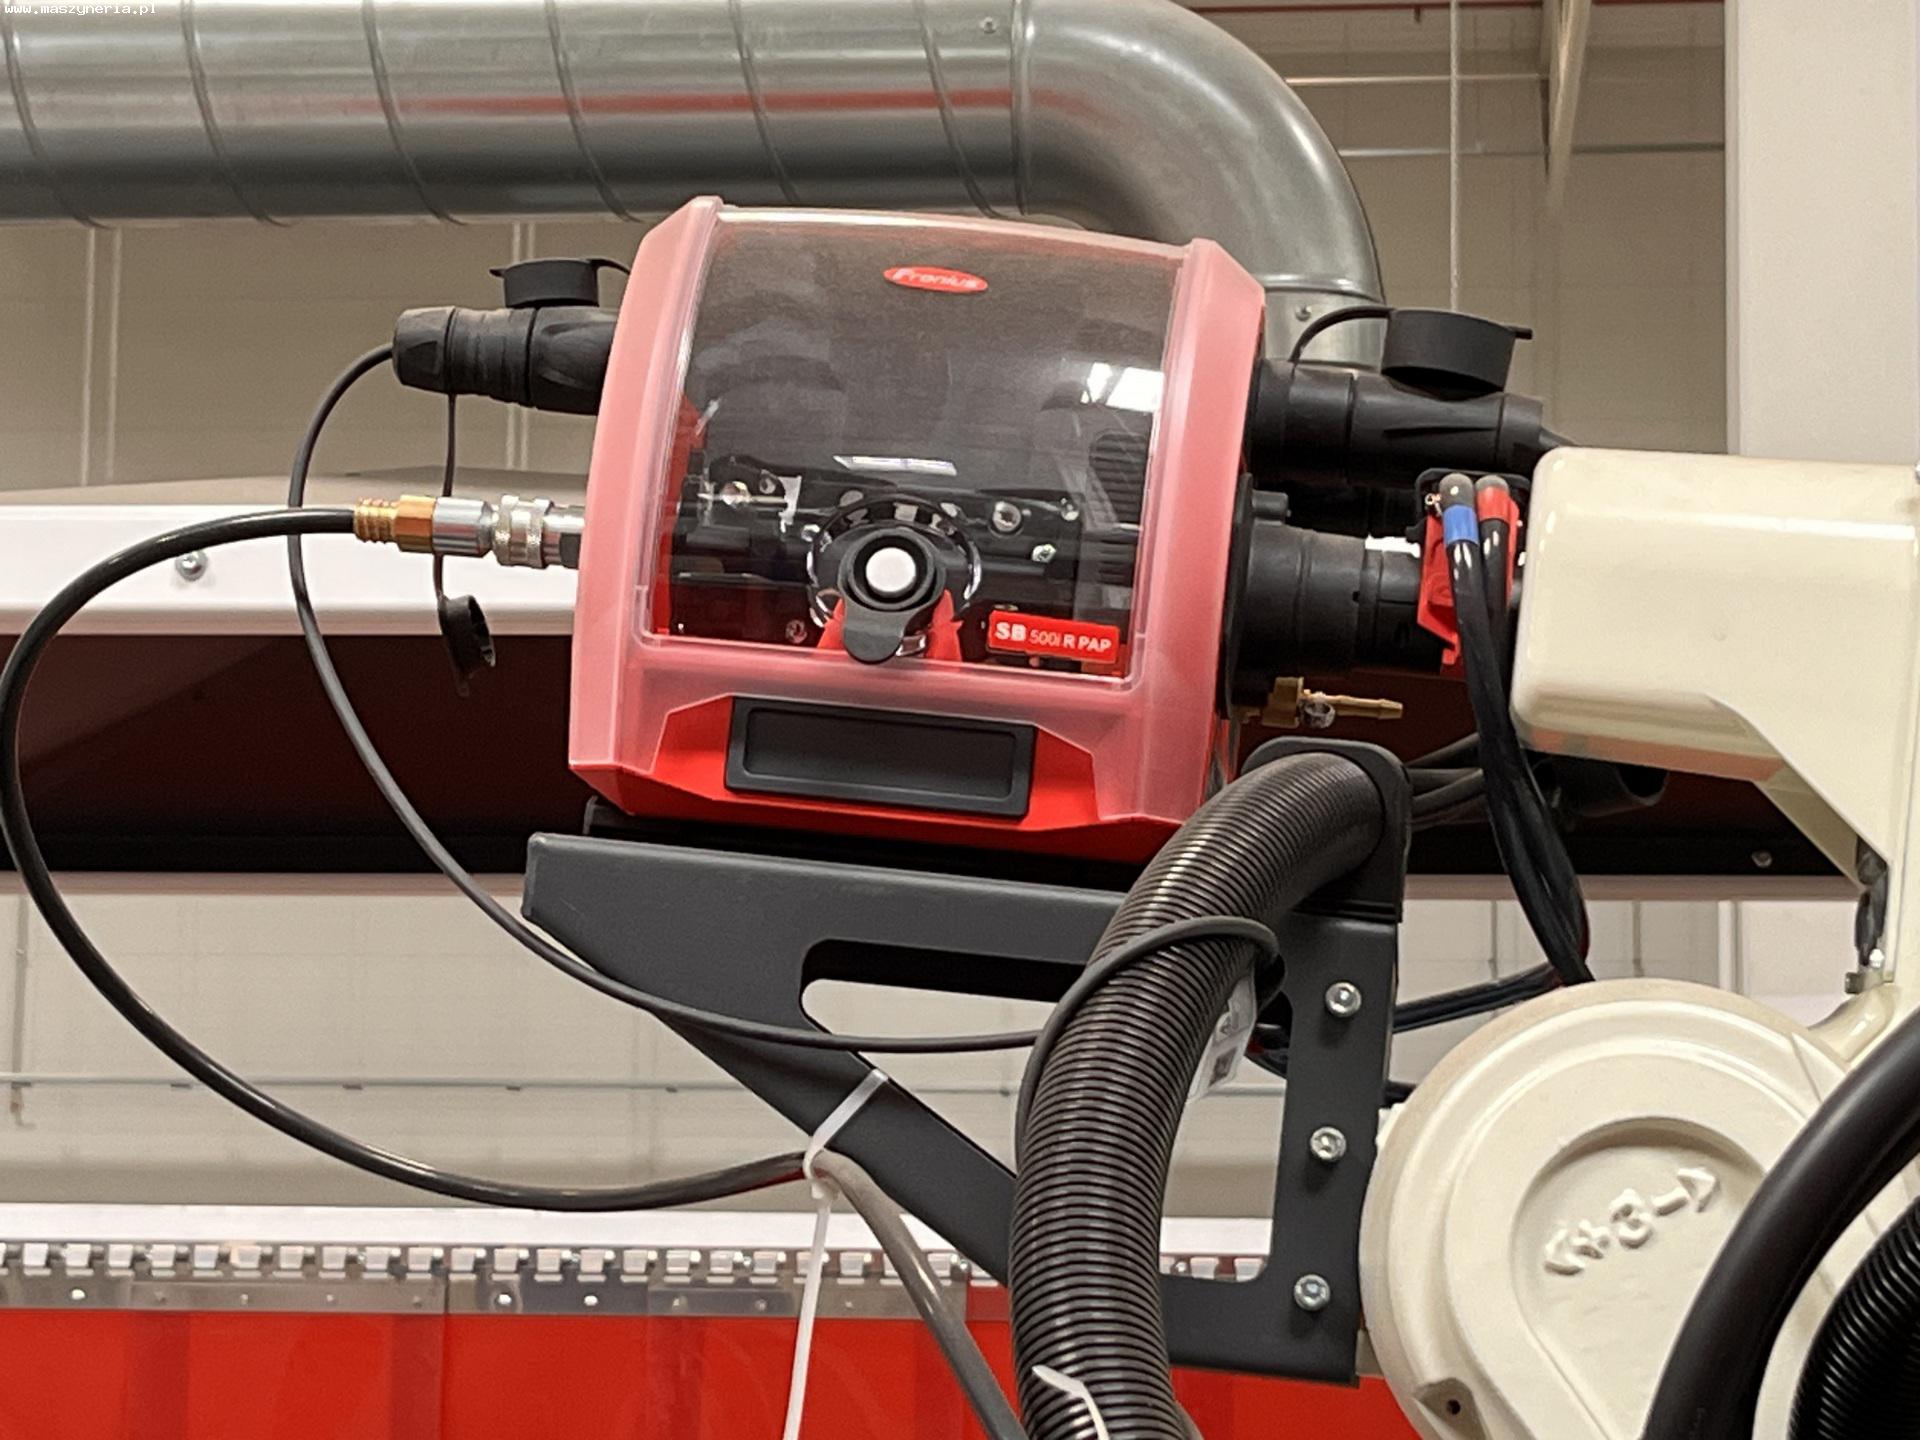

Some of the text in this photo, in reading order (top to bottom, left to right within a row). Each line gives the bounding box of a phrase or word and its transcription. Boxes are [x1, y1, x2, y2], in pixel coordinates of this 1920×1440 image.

[892, 268, 978, 289] Fronius
[995, 622, 1026, 641] SB
[1063, 633, 1075, 648] R
[1078, 635, 1111, 652] PAP
